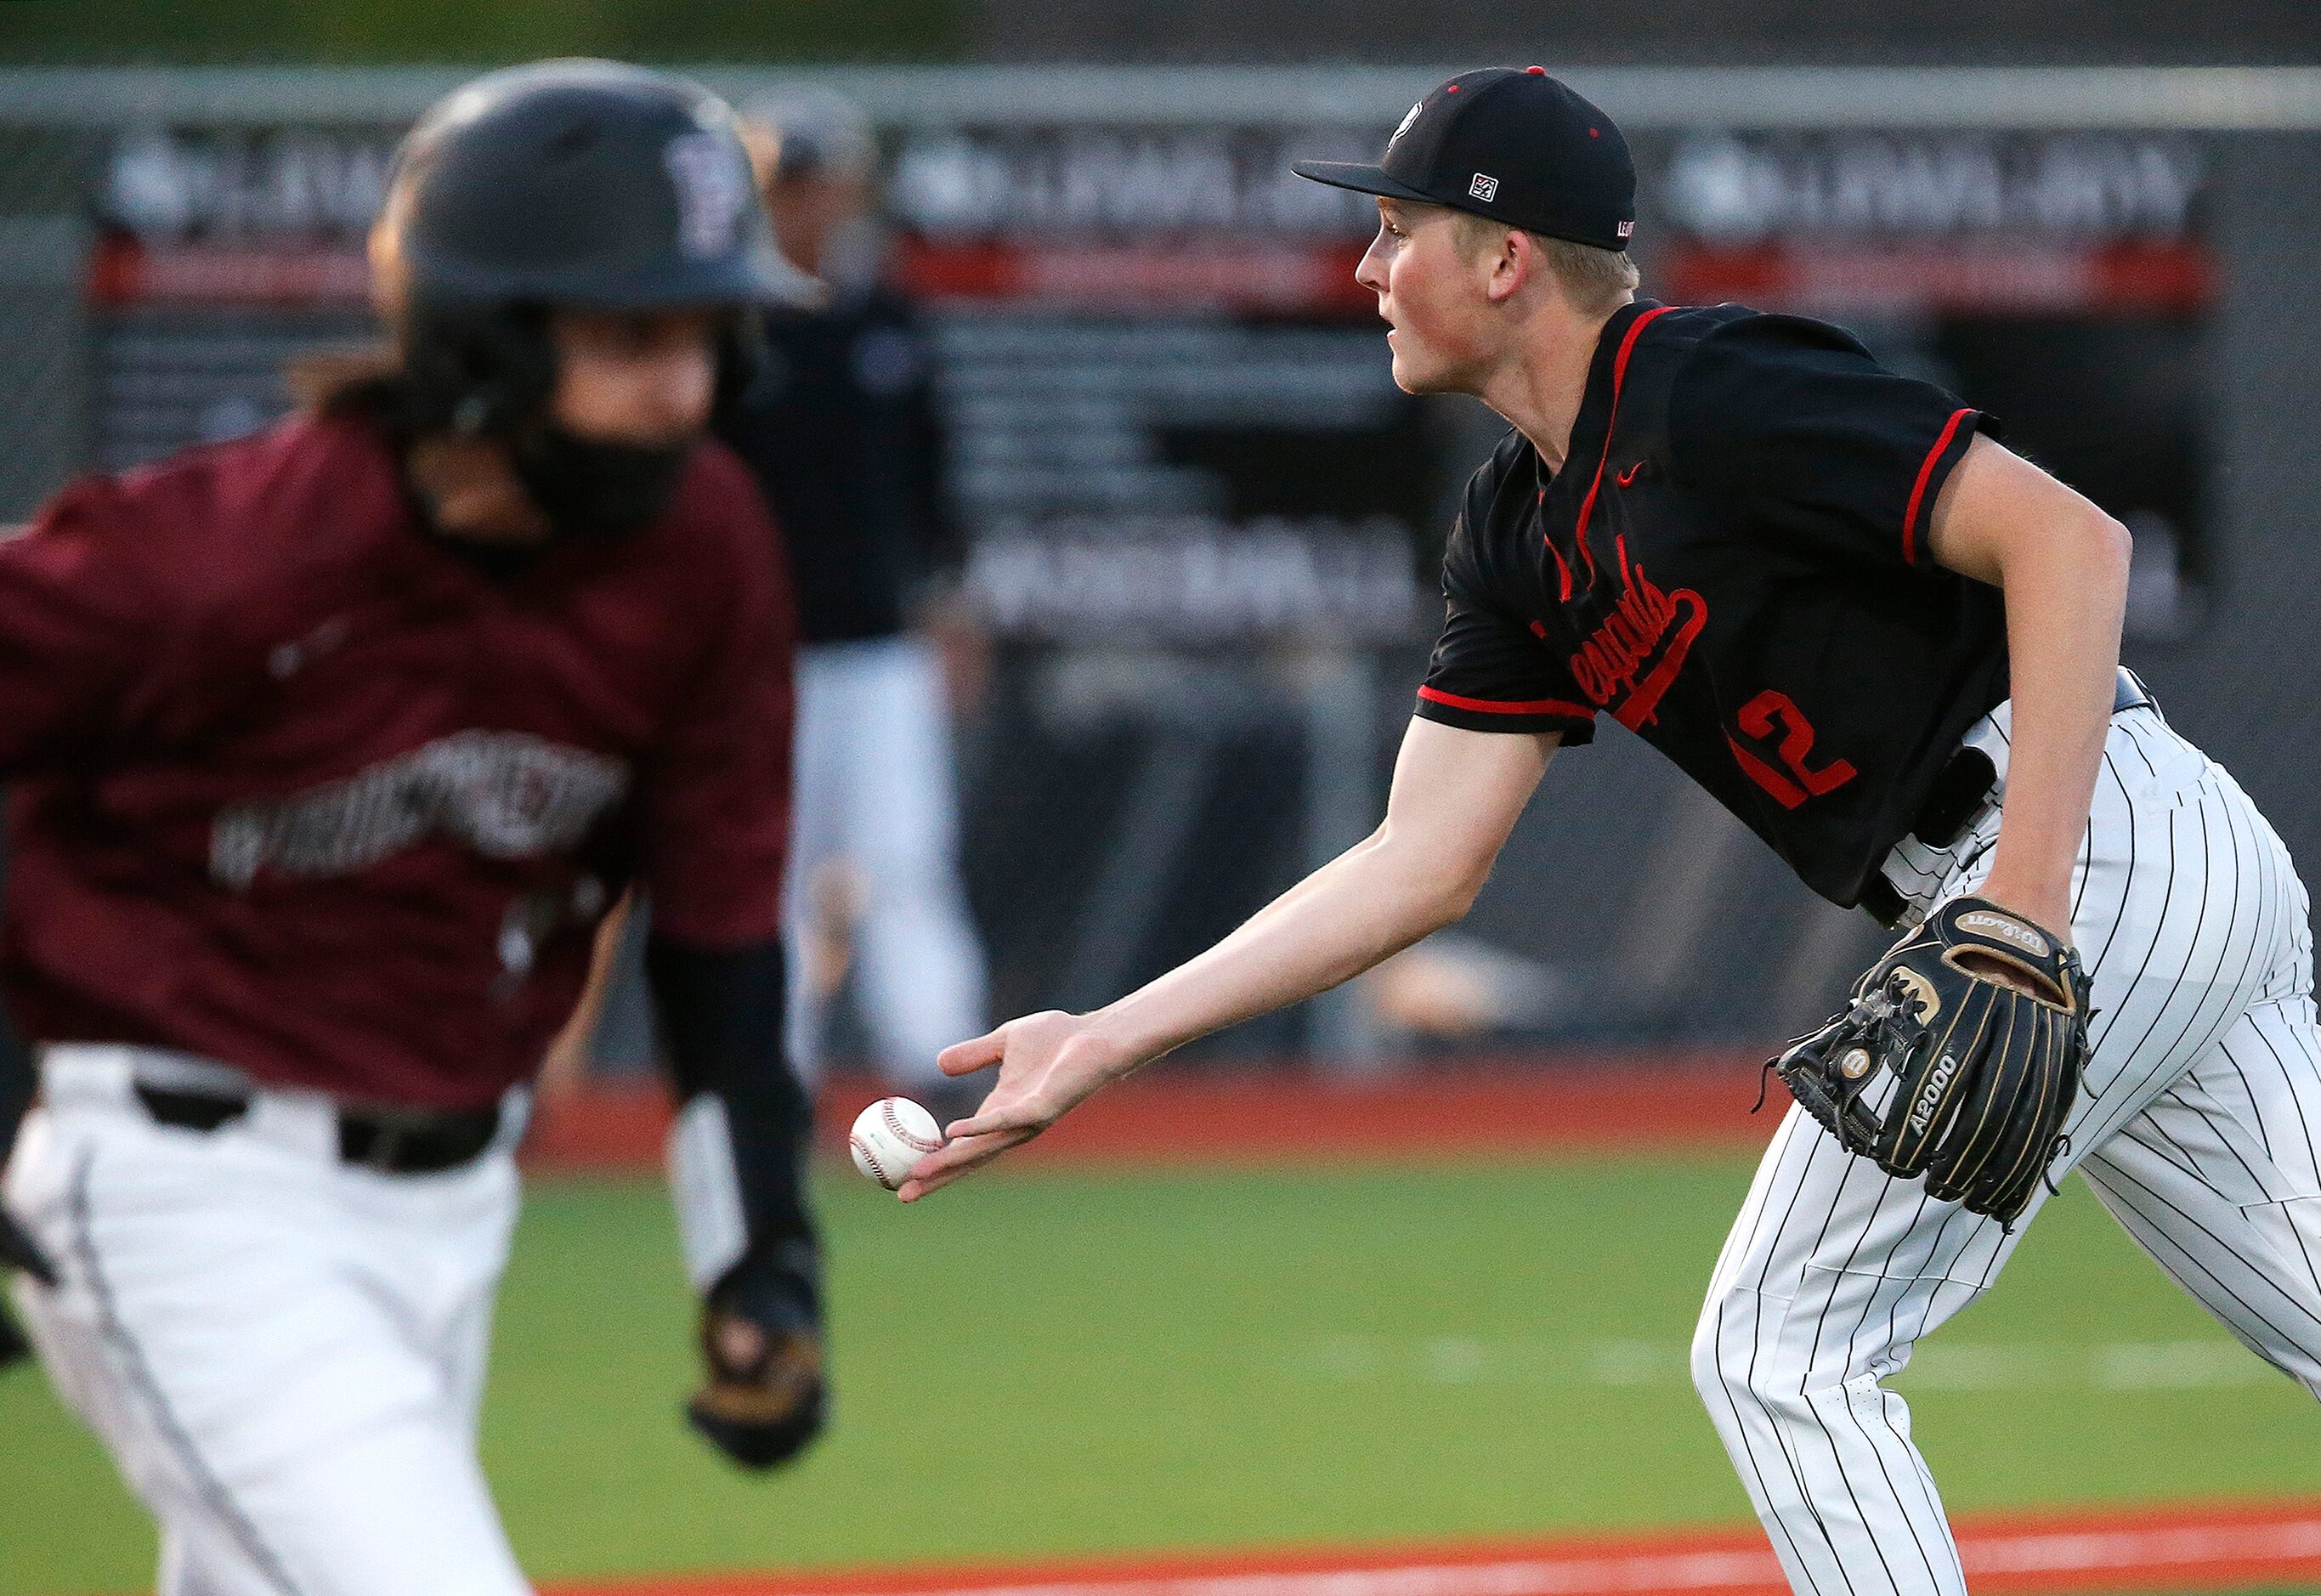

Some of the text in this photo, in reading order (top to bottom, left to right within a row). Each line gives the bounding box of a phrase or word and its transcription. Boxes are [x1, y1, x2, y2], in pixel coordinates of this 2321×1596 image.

[1568, 533, 1708, 727] eopards
[1725, 689, 1858, 809] 12
[1966, 915, 2042, 952] Wilson
[1911, 1055, 1956, 1137] A2000
